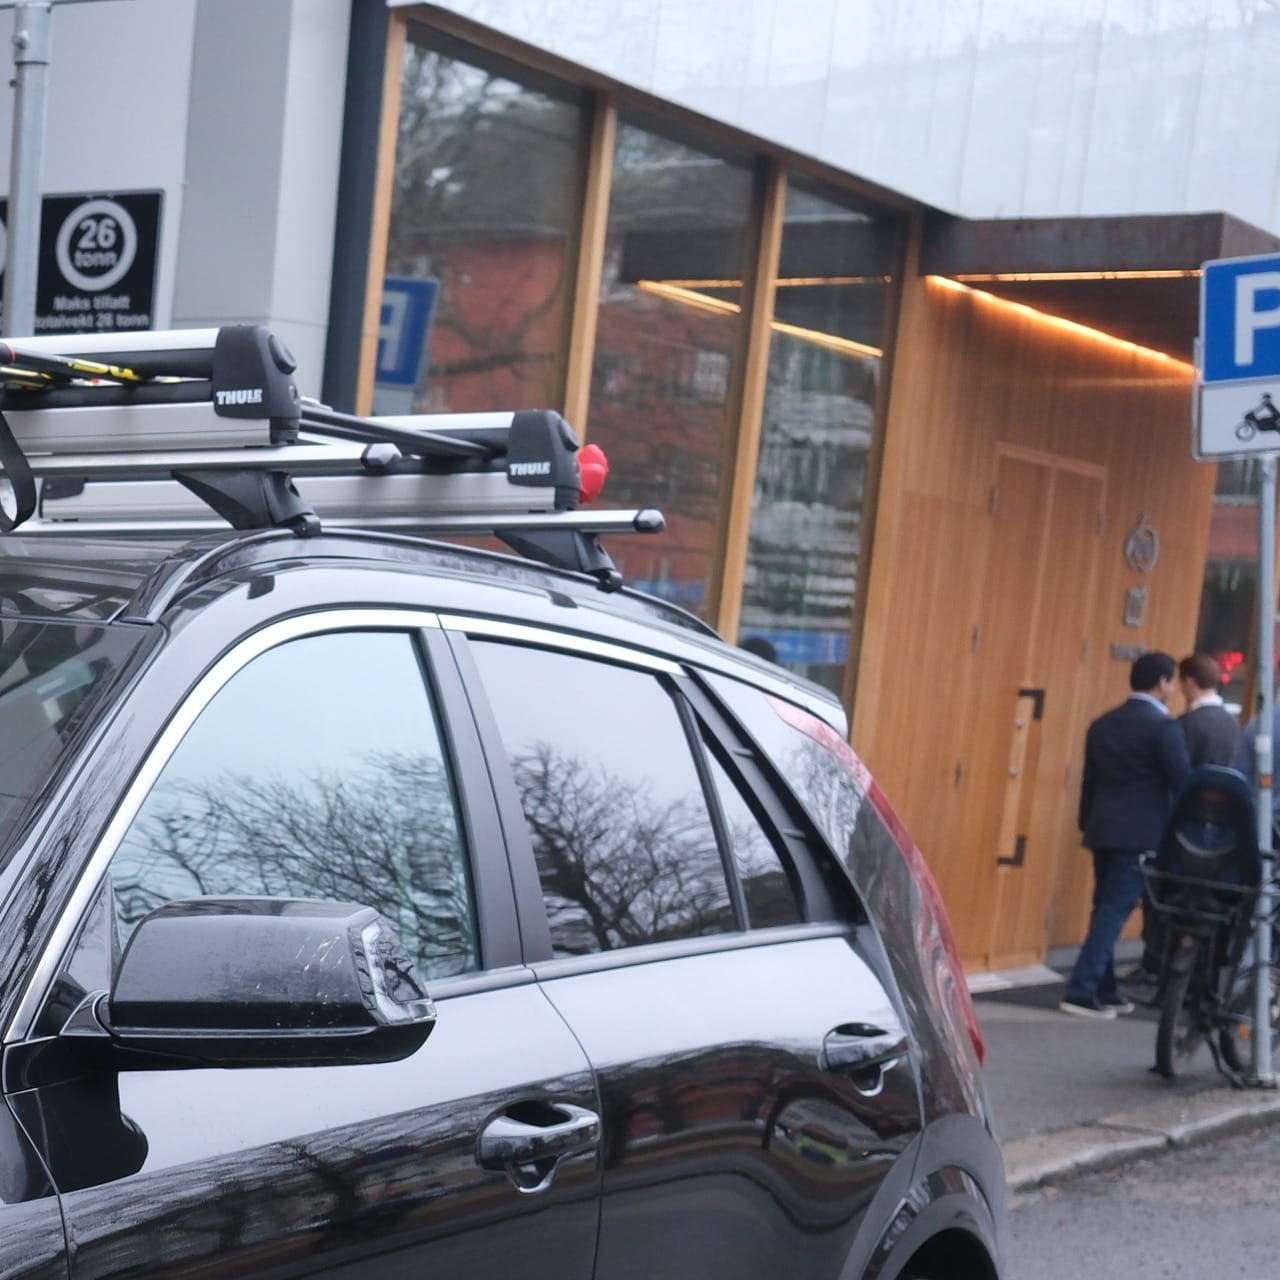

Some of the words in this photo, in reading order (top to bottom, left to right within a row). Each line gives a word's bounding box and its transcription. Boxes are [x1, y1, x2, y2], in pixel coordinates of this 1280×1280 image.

[78, 219, 117, 250] 26
[74, 249, 117, 268] tonn
[53, 296, 91, 311] Maks
[116, 313, 150, 328] tonn
[1233, 271, 1280, 367] P
[216, 388, 263, 405] THULE
[509, 461, 551, 476] THULE
